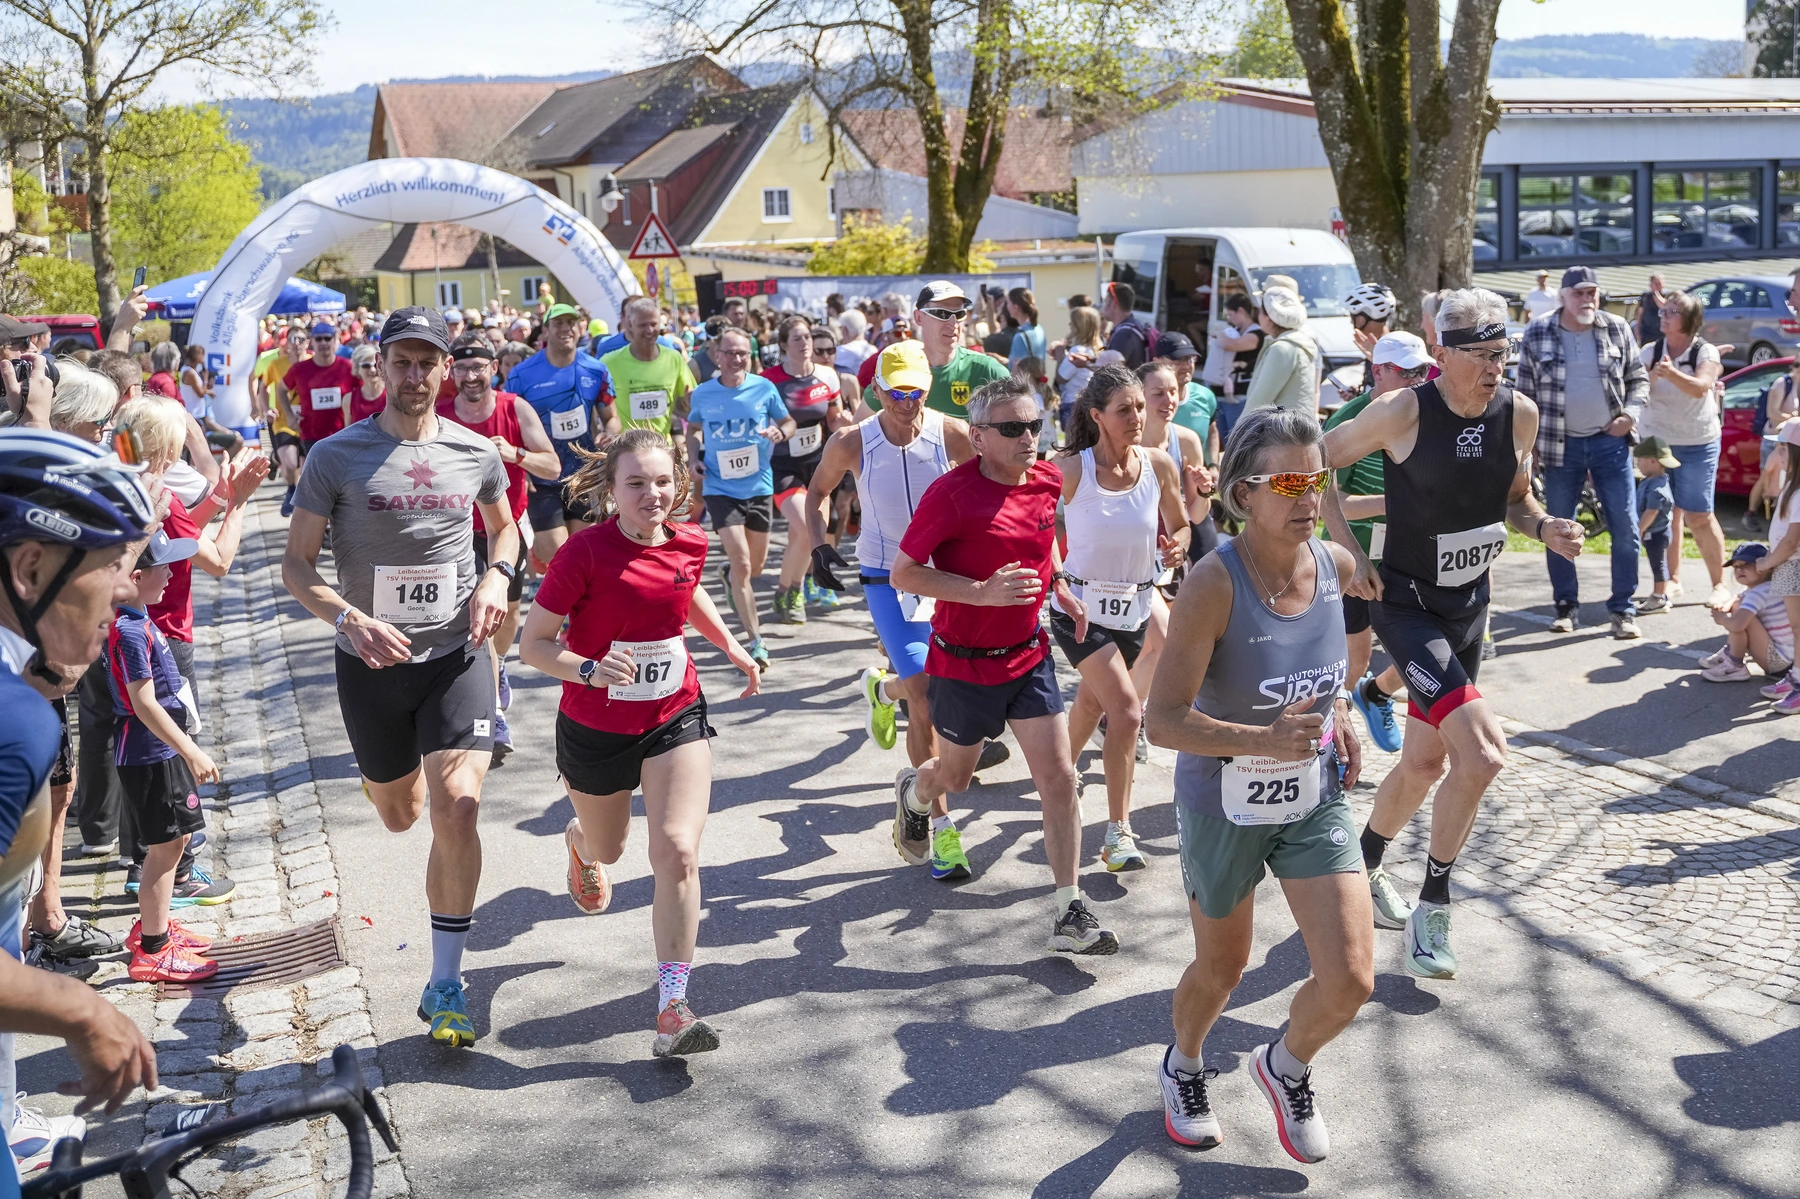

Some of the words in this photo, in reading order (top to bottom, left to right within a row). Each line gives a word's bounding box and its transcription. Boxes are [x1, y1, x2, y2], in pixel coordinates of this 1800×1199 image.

[335, 180, 397, 207] Herzlich
[401, 177, 506, 205] willkommen!
[209, 290, 234, 345] Volksbank
[318, 394, 335, 404] 238
[639, 399, 659, 410] 489
[559, 418, 580, 432] 153
[798, 433, 817, 447] 113
[1456, 445, 1483, 453] CYCLING
[728, 455, 750, 469] 107
[58, 477, 92, 495] movistar
[367, 493, 470, 512] SAYSKY
[33, 512, 75, 538] ABUS
[396, 511, 448, 522] copenhagen
[1440, 539, 1505, 573] 20873
[397, 567, 439, 575] Leiblachlauf
[401, 574, 448, 582] Hergensweiler
[395, 582, 439, 604] 148
[1098, 597, 1132, 617] 197
[422, 614, 440, 622] AOK
[1256, 635, 1272, 643] JAKO
[633, 660, 672, 684] 167
[1287, 663, 1339, 683] AUTOHAUS
[1407, 664, 1439, 693] HAMMER
[1252, 667, 1347, 710] SIRCH
[1246, 776, 1300, 805] 225
[1282, 810, 1302, 822] AOK
